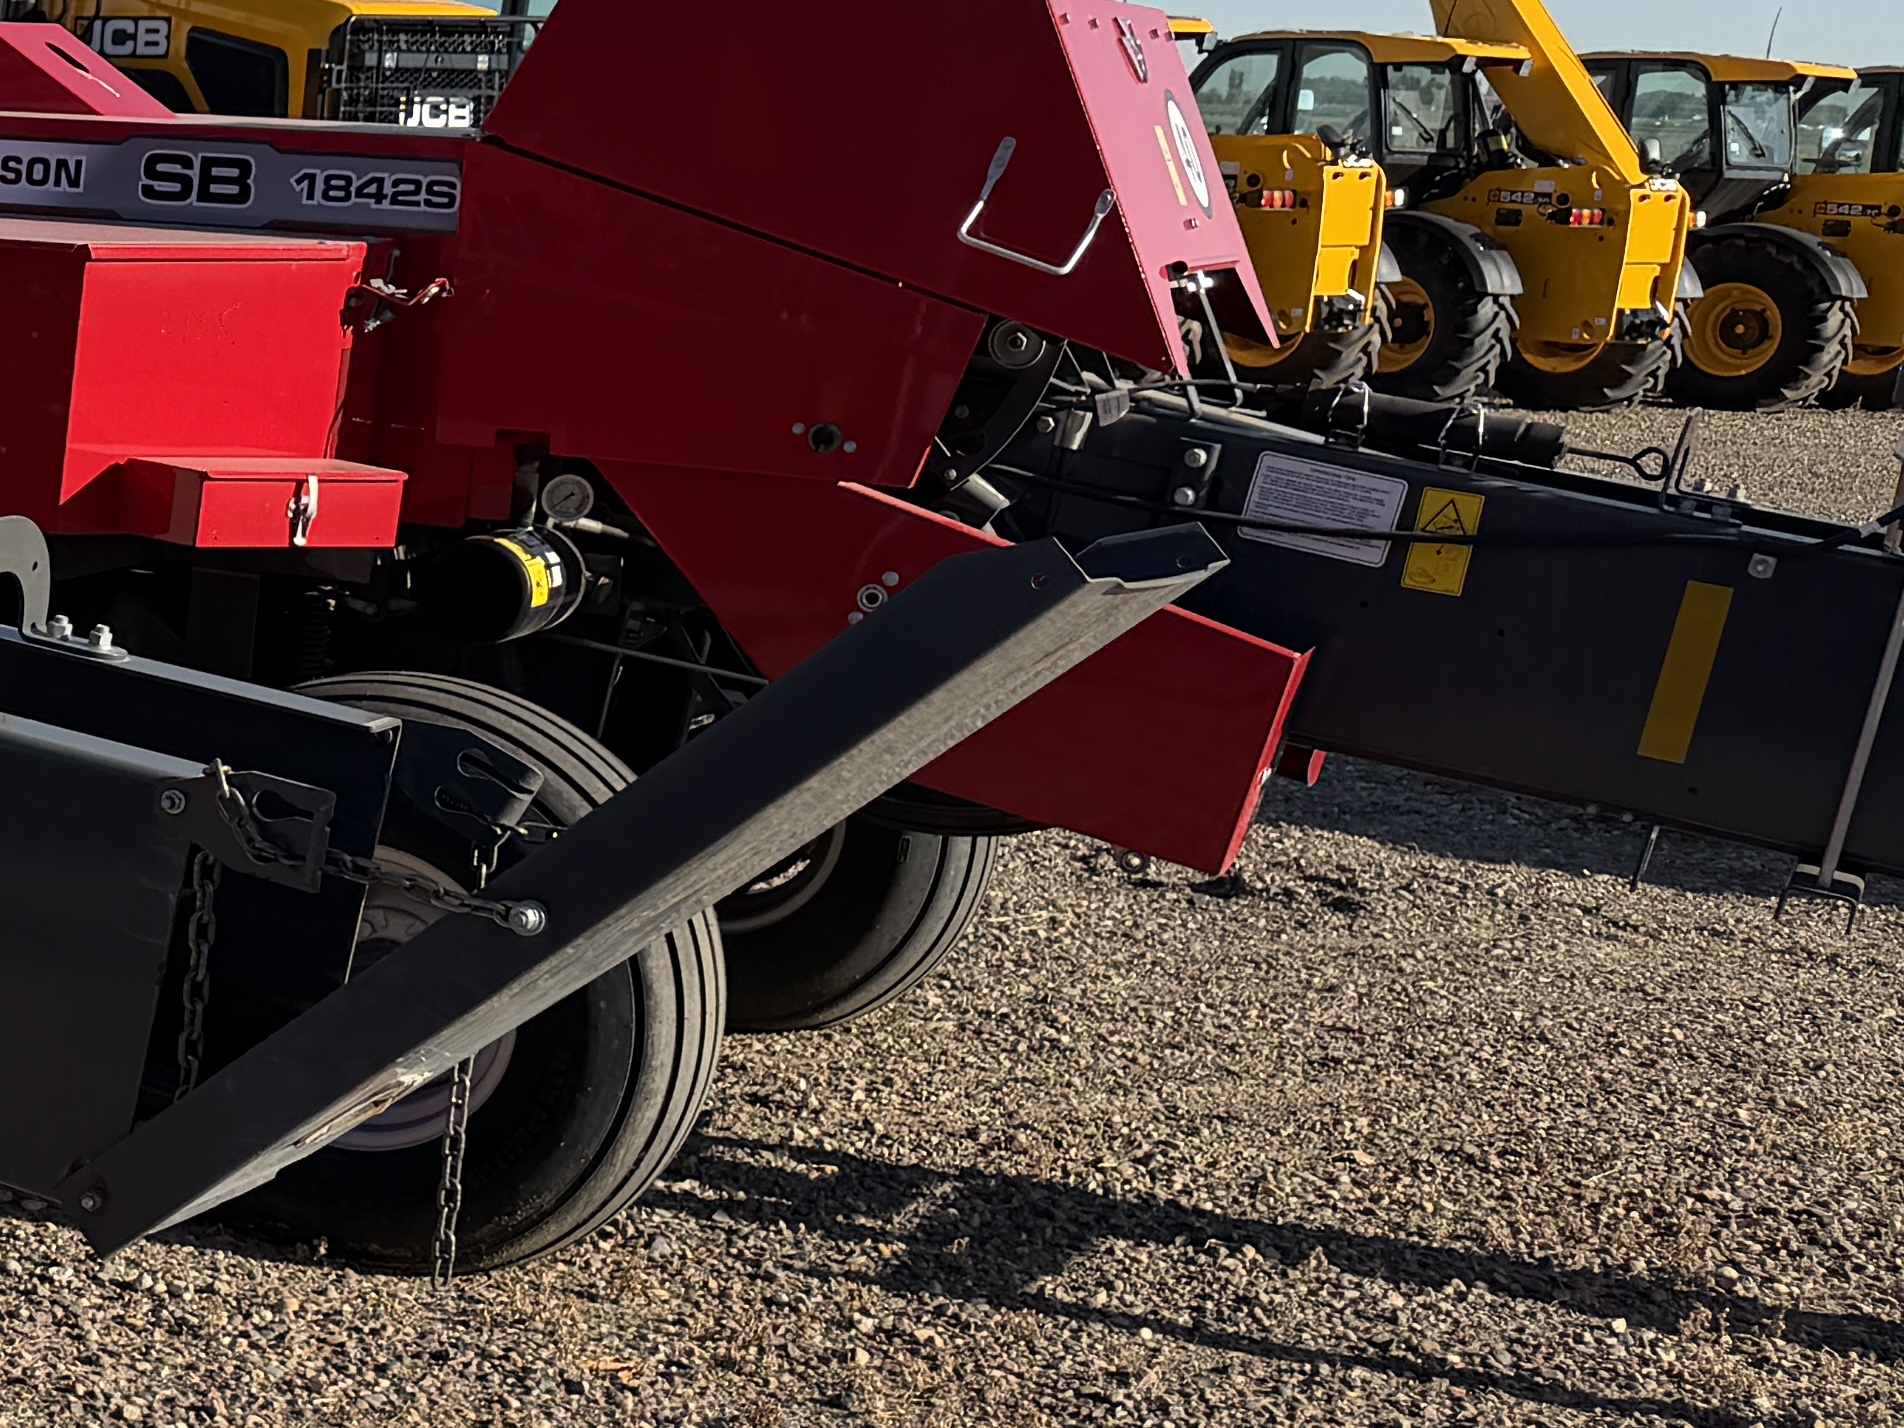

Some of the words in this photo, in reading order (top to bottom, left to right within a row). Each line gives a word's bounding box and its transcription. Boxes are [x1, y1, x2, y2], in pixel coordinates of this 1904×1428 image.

[89, 18, 170, 57] JCB
[398, 95, 474, 128] JCB
[139, 151, 255, 208] SB
[291, 167, 460, 212] 1842S
